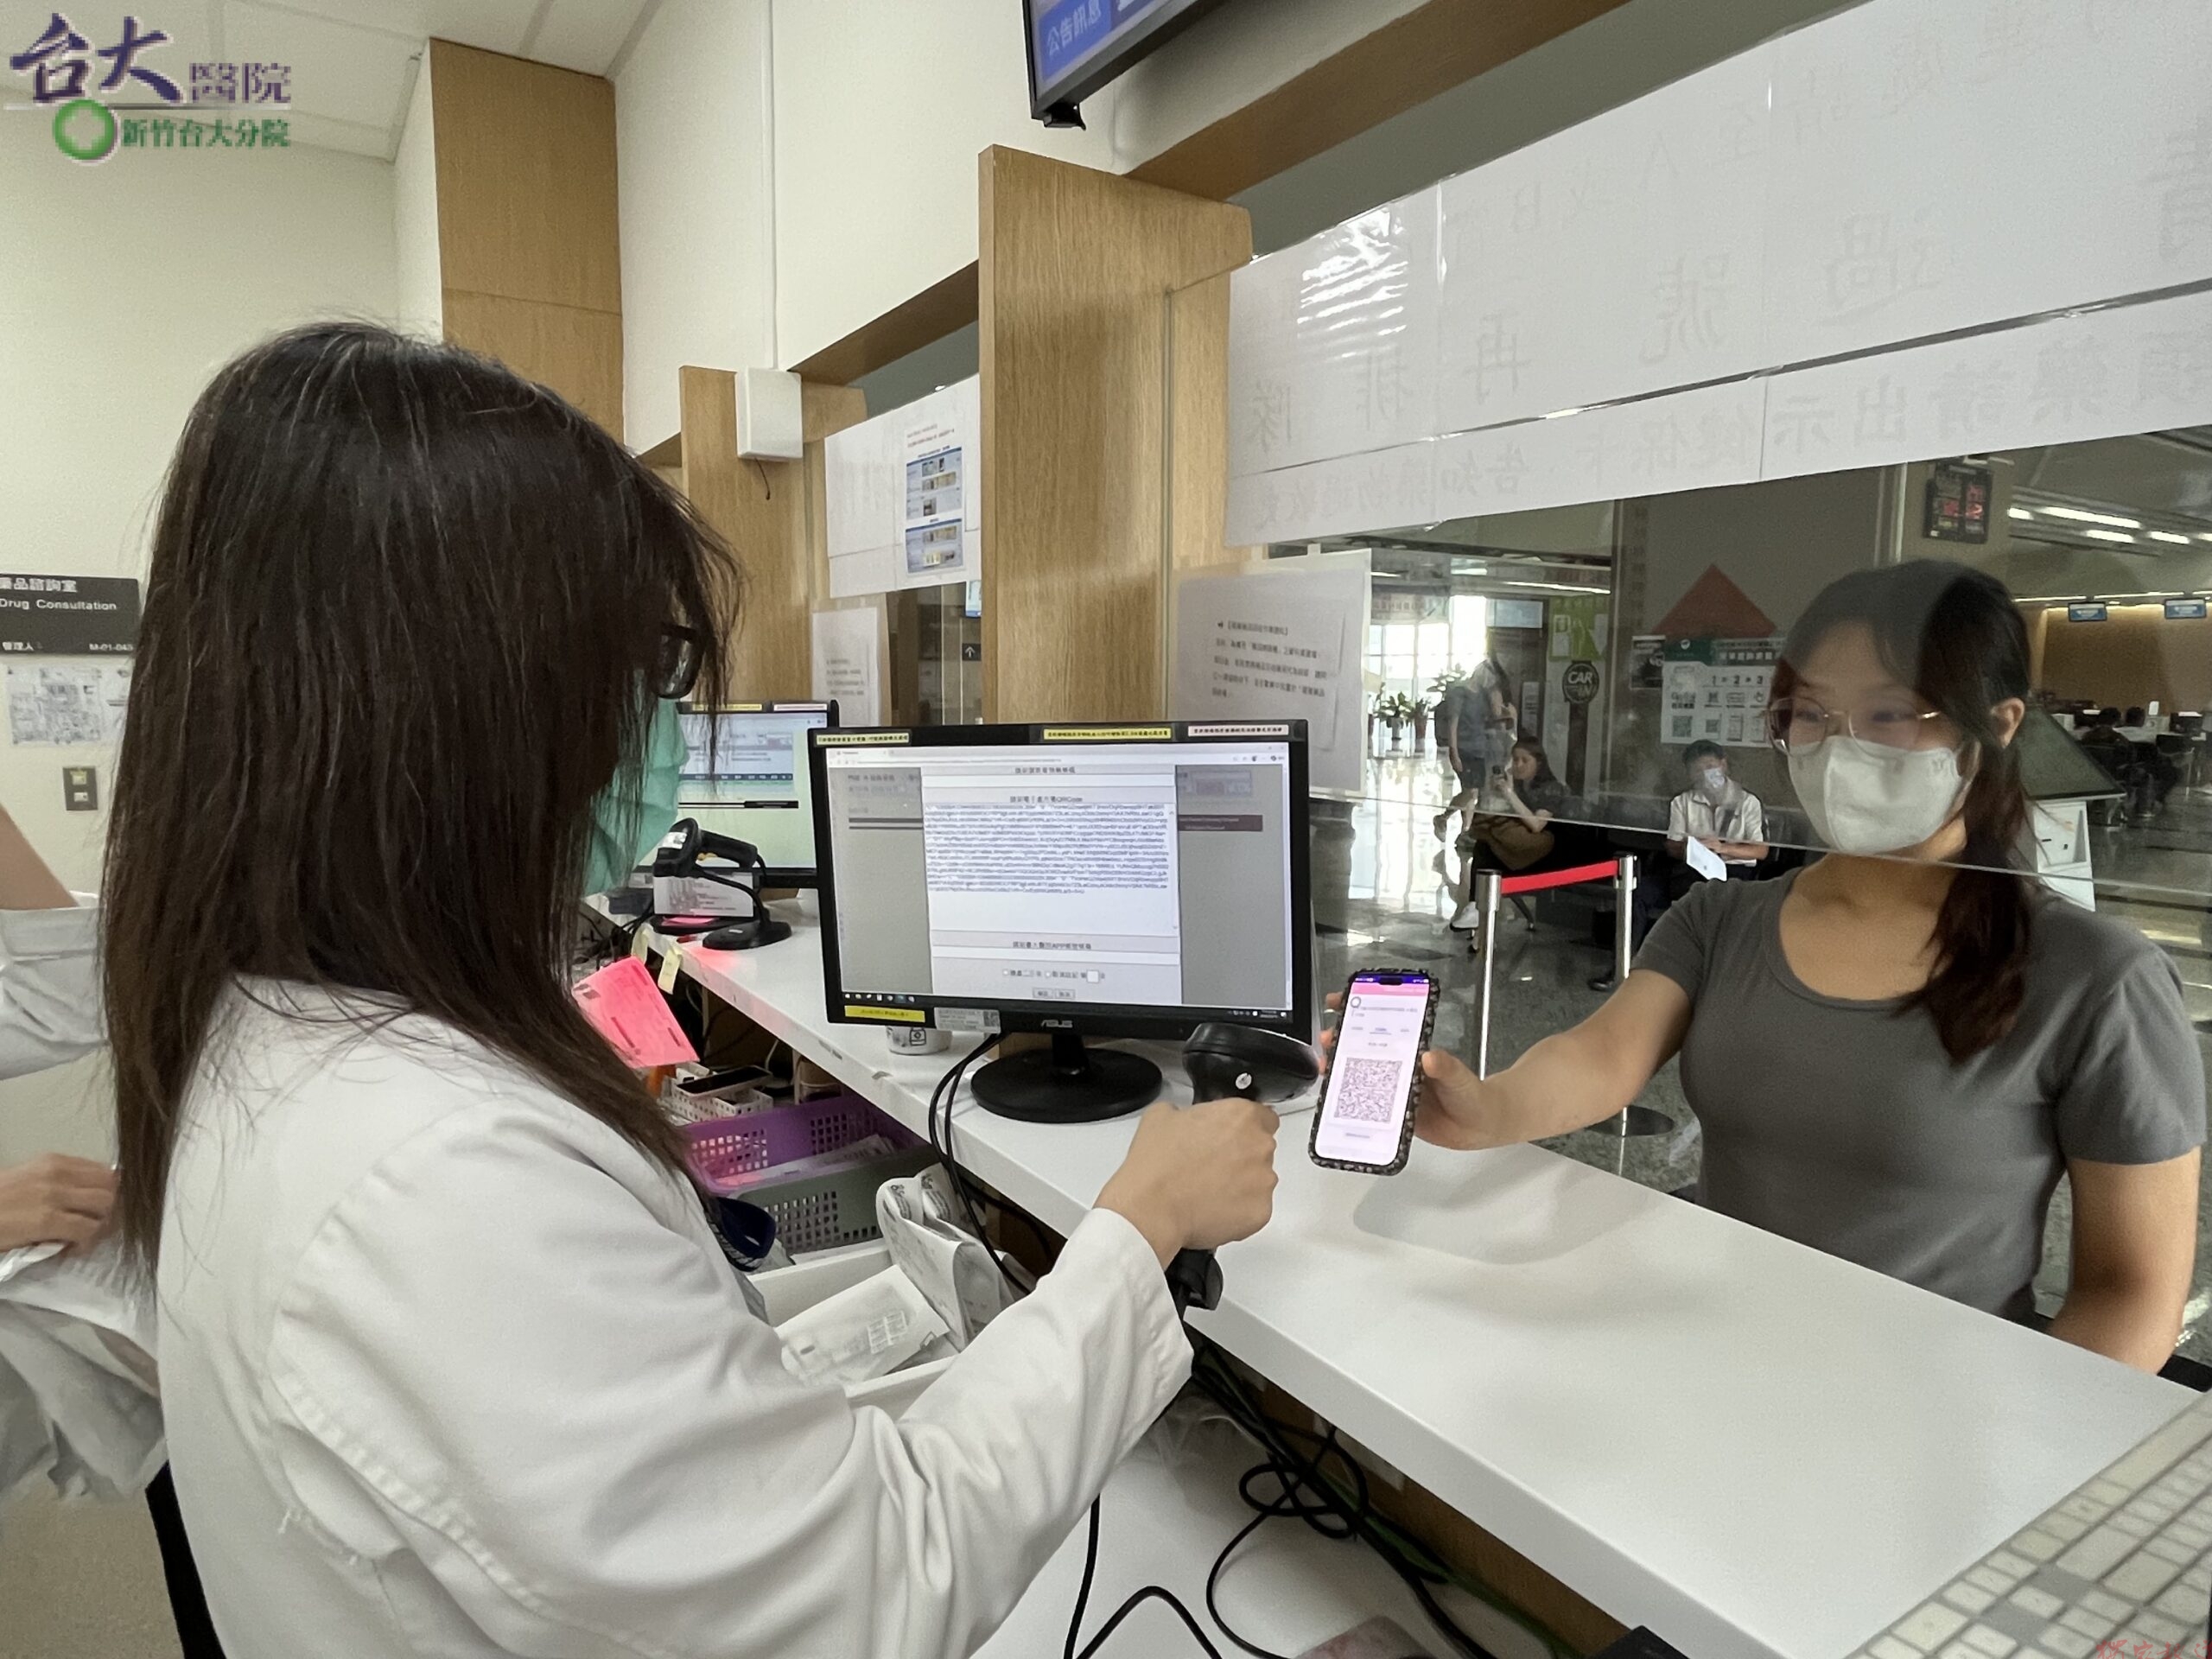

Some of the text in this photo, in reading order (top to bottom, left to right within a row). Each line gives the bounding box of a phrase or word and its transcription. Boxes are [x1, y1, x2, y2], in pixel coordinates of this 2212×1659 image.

[1047, 0, 1102, 58] 公告訊息
[0, 598, 118, 611] Drug Consultation
[1567, 671, 1593, 684] CAR
